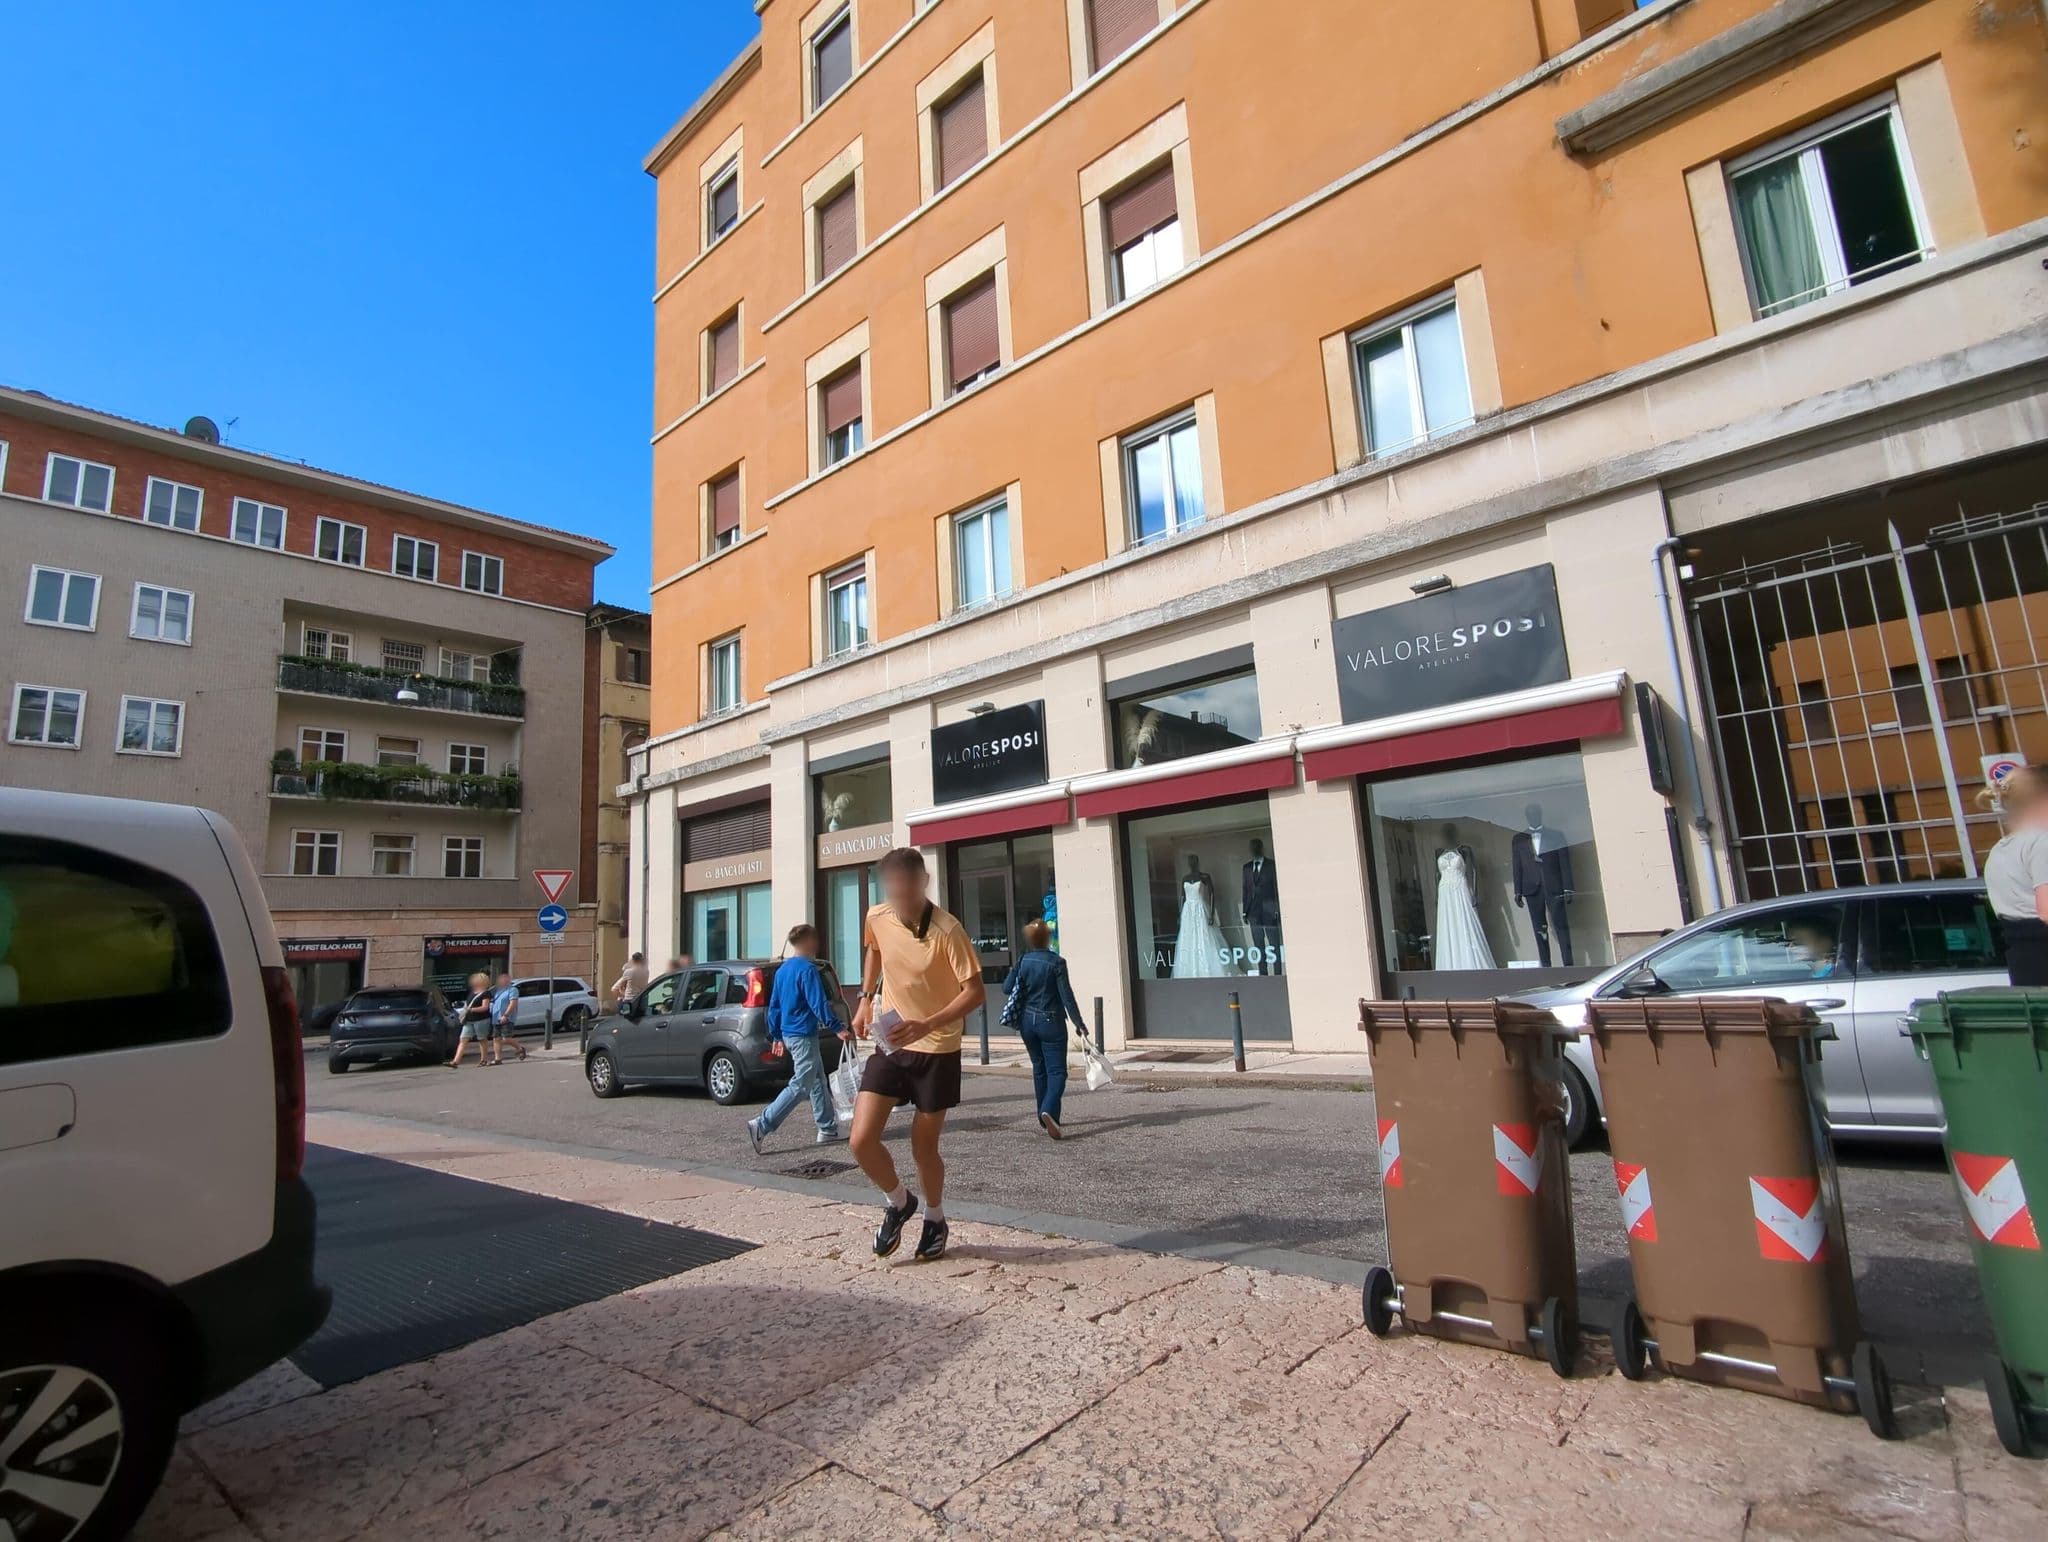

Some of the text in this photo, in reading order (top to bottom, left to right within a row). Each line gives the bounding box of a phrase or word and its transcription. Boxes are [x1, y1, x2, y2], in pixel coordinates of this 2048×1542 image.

[835, 839, 865, 856] BANCA
[866, 836, 876, 850] DI
[715, 860, 762, 879] BANCA DI ASTI
[320, 943, 341, 951] BLACK
[1144, 944, 1286, 968] VALSPOSI
